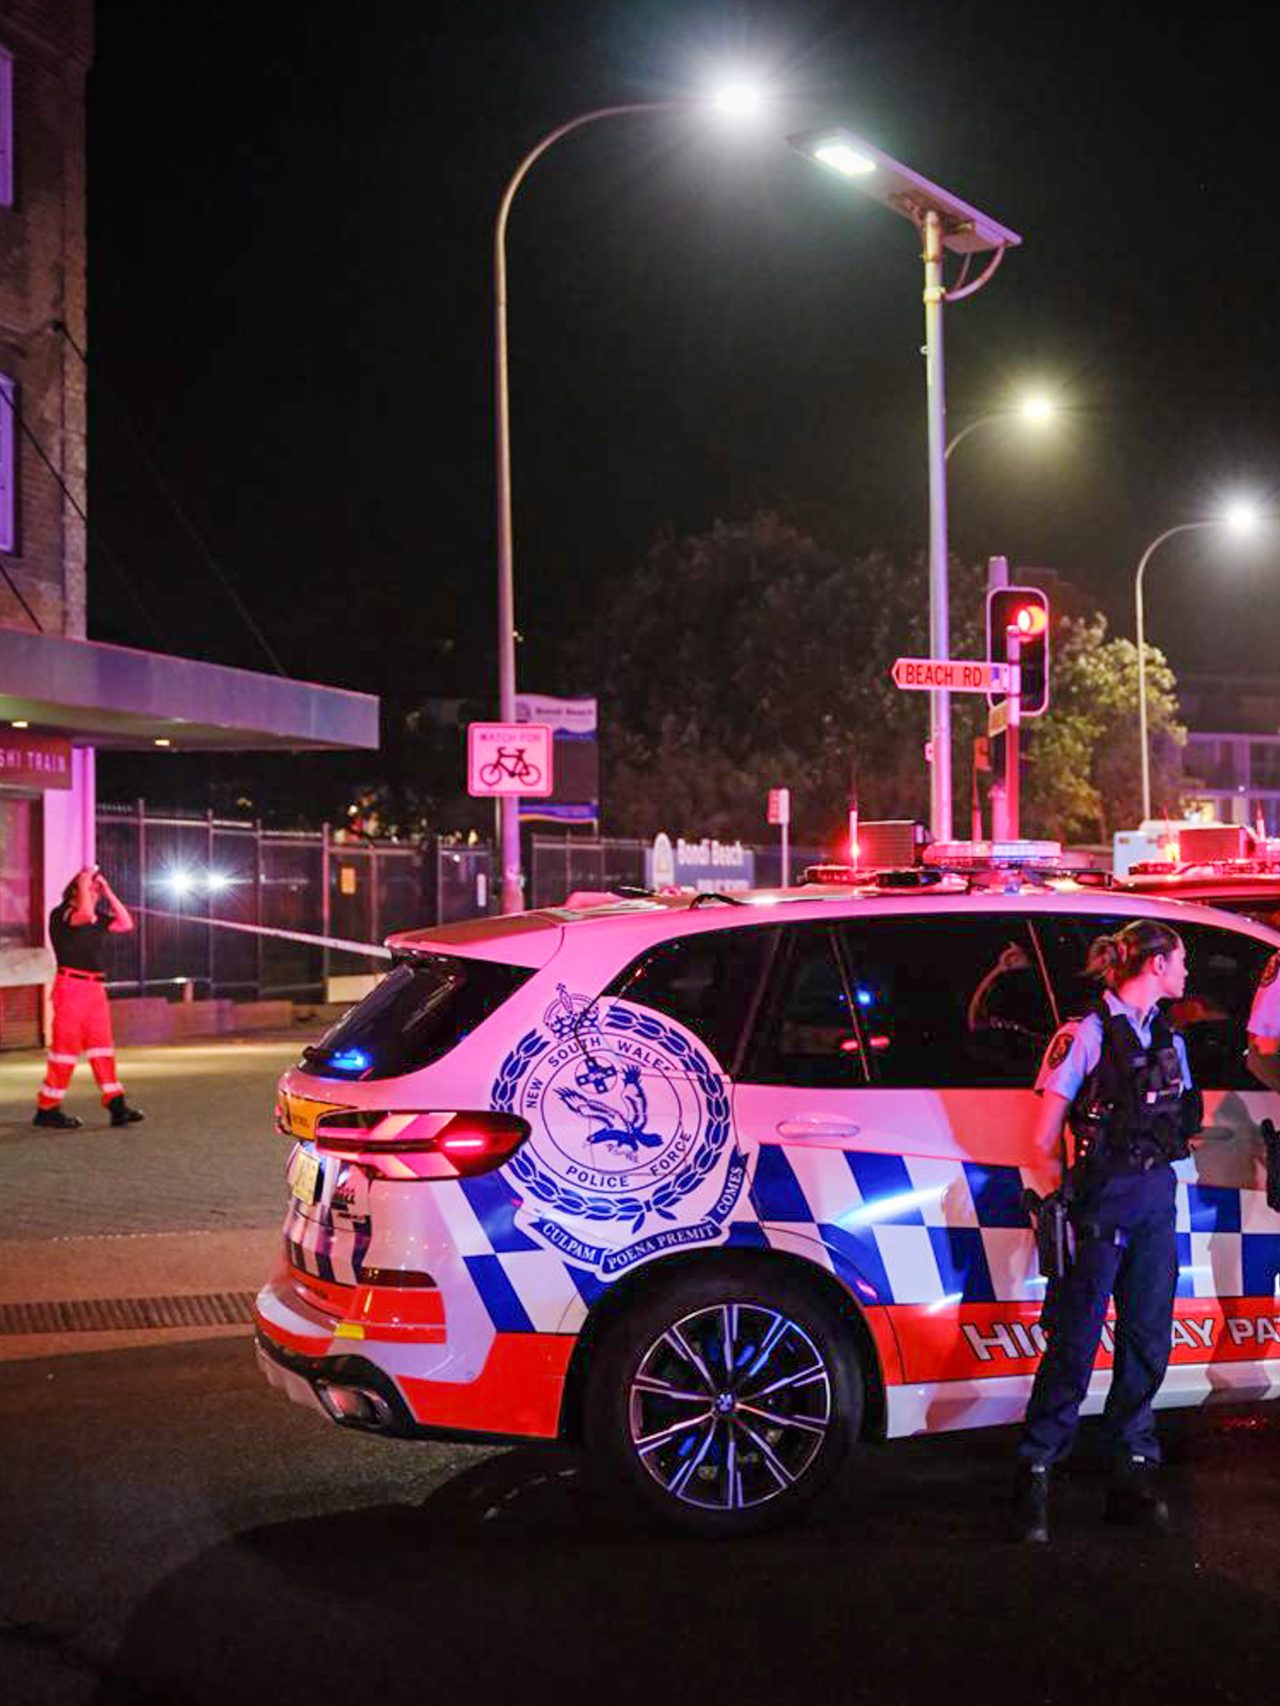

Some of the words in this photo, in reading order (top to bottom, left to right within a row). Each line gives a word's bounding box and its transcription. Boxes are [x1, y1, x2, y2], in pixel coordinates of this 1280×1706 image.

[905, 663, 954, 686] BEACH
[963, 666, 983, 687] RD
[27, 751, 66, 773] TRAIN
[526, 1078, 544, 1109] NEW
[548, 1037, 601, 1068] SOUTH
[565, 1165, 630, 1188] POLICE
[650, 1132, 692, 1177] FORCE
[542, 1222, 597, 1262] CULPAM
[607, 1236, 657, 1270] POENA
[657, 1224, 715, 1248] PREMIT
[717, 1165, 743, 1215] COMES
